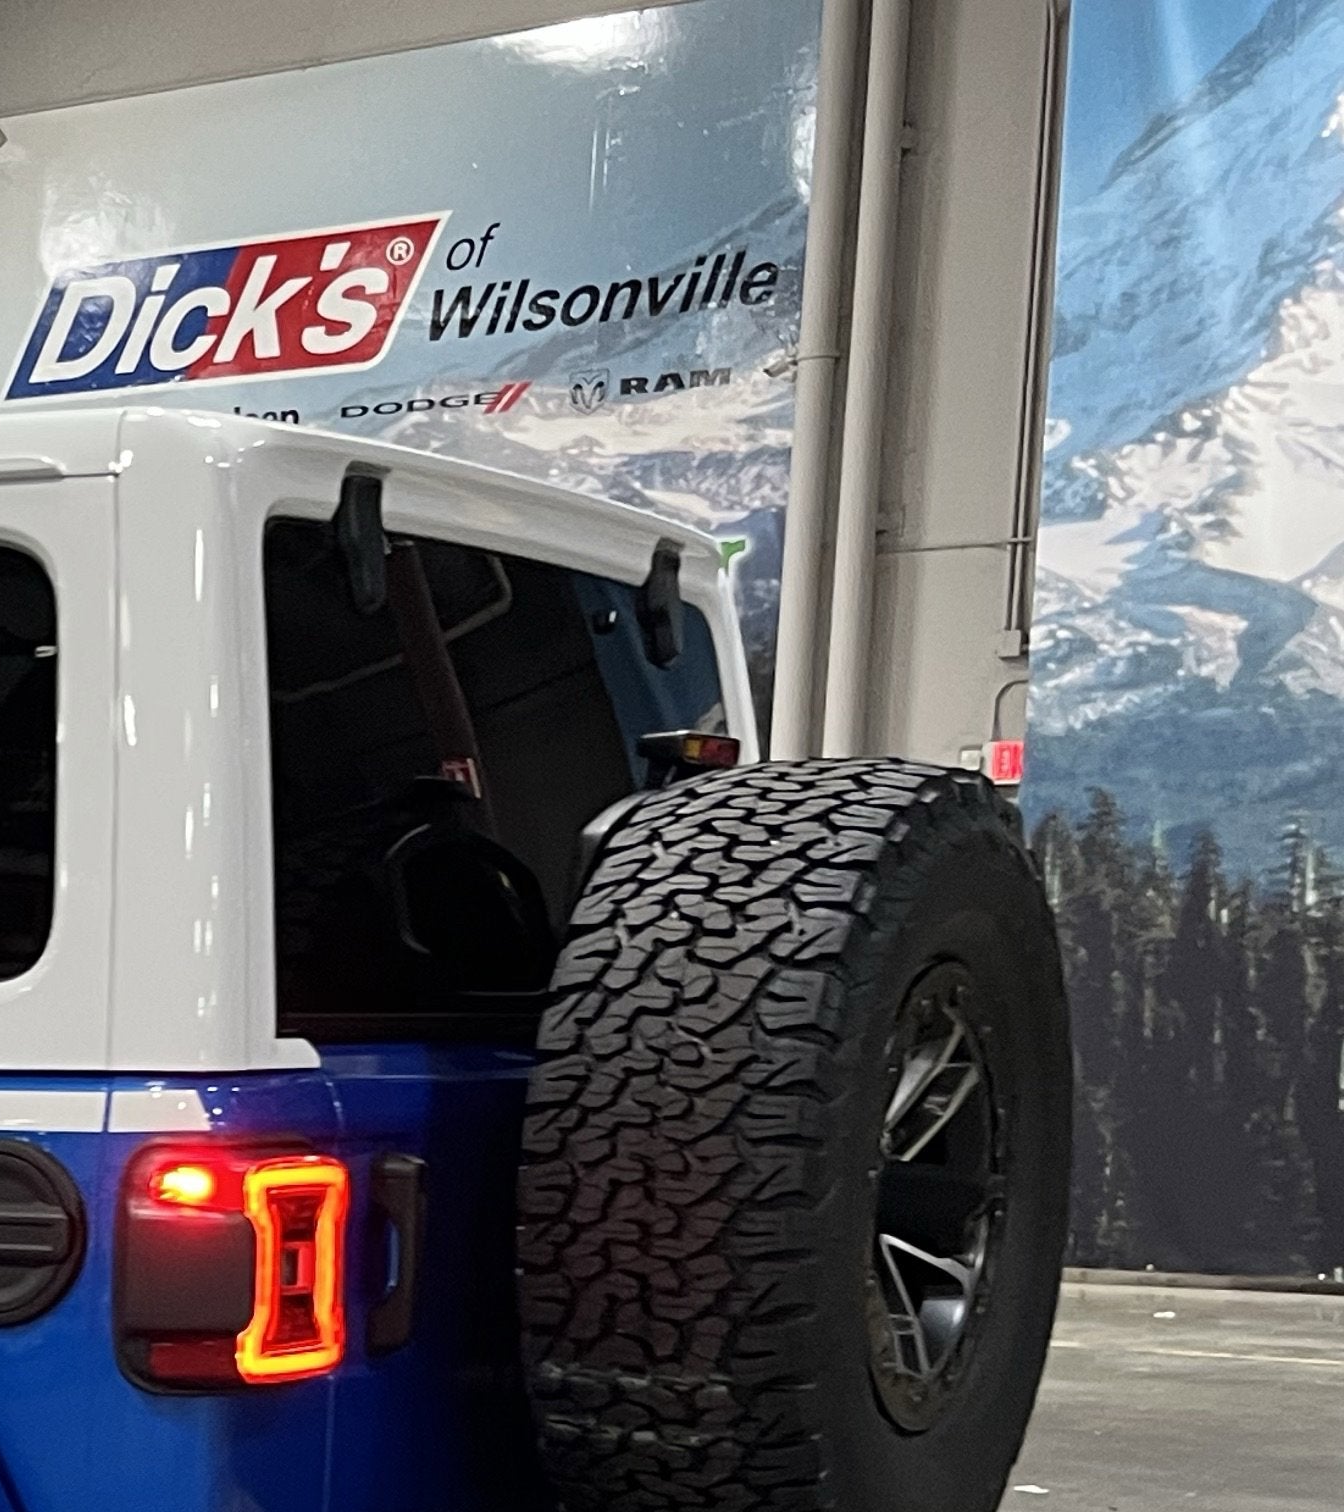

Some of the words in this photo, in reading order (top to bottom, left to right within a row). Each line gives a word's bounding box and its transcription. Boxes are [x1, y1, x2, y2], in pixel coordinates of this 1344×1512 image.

[28, 241, 390, 384] Dick's
[445, 223, 501, 272] of
[427, 250, 780, 342] Wilsonville
[340, 391, 499, 419] DODGE
[619, 367, 732, 396] RAM
